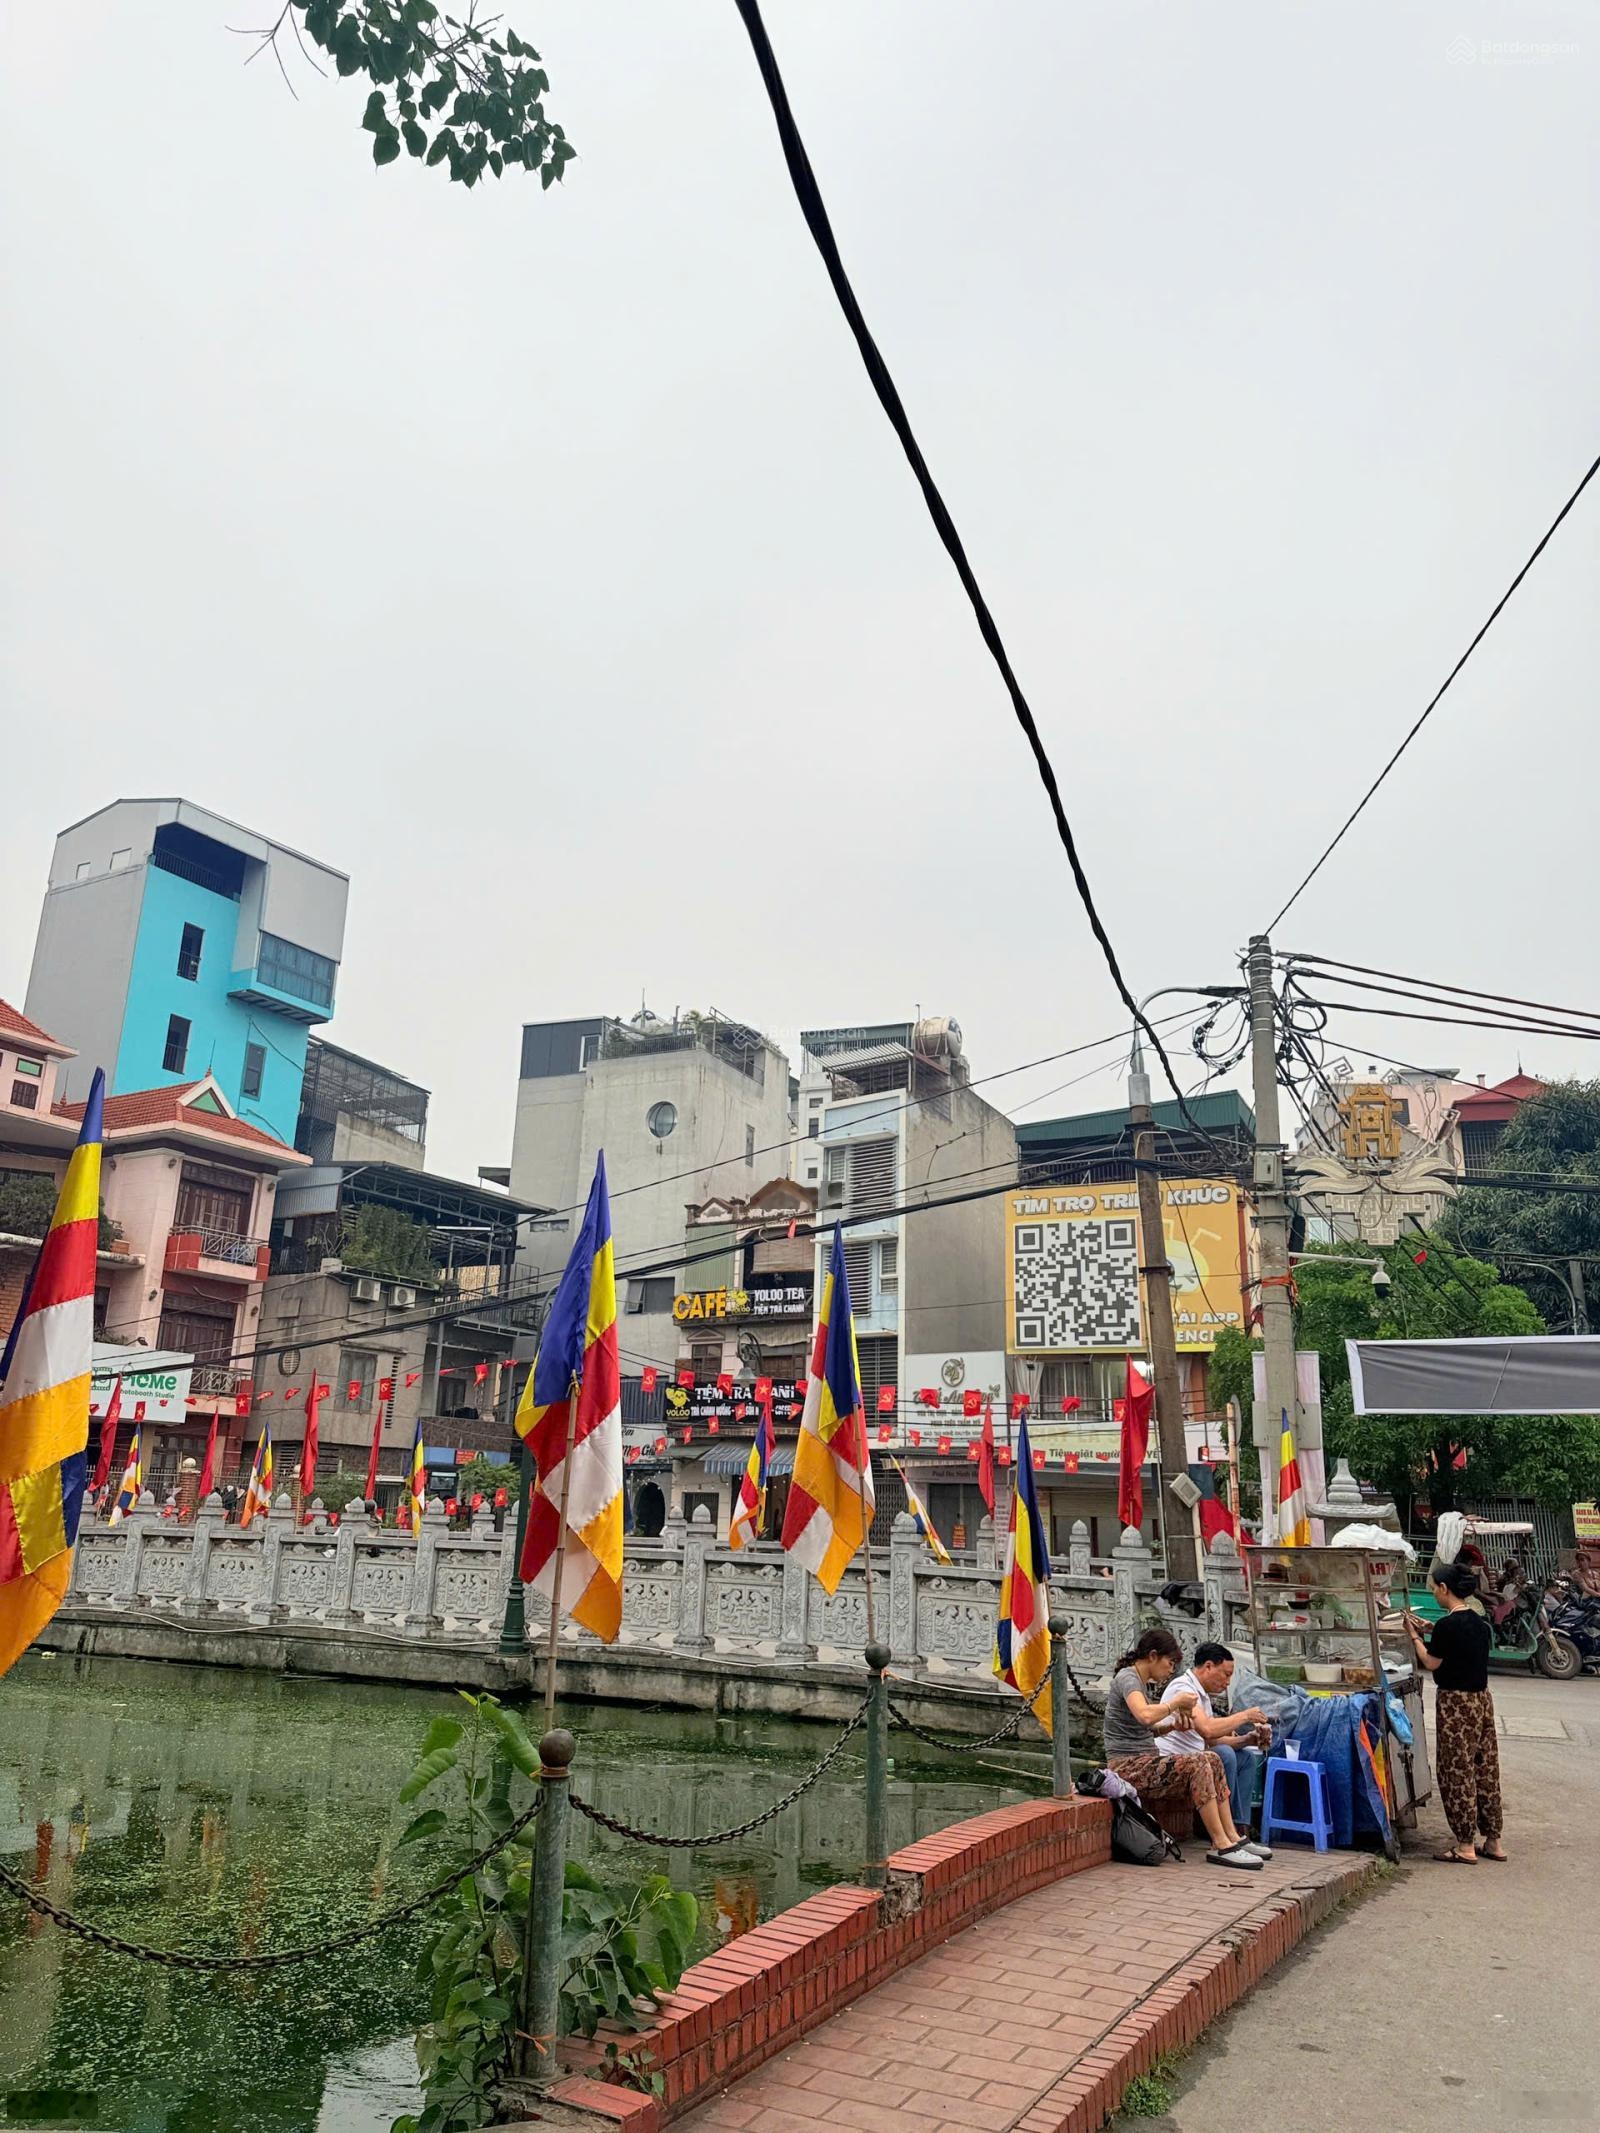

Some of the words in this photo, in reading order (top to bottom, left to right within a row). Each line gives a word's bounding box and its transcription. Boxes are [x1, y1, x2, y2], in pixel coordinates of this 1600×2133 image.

[1013, 1195, 1050, 1216] TÌM
[1053, 1195, 1097, 1215] TRỌ
[1167, 1184, 1229, 1206] KHÚC
[754, 1289, 783, 1301] YOLOO
[785, 1287, 805, 1300] TEA
[673, 1285, 727, 1320] CAFÉ
[1200, 1312, 1240, 1325] APP
[120, 1388, 153, 1397] hotobooth
[695, 1384, 723, 1403] TIỆM
[666, 1409, 690, 1417] YOLOO
